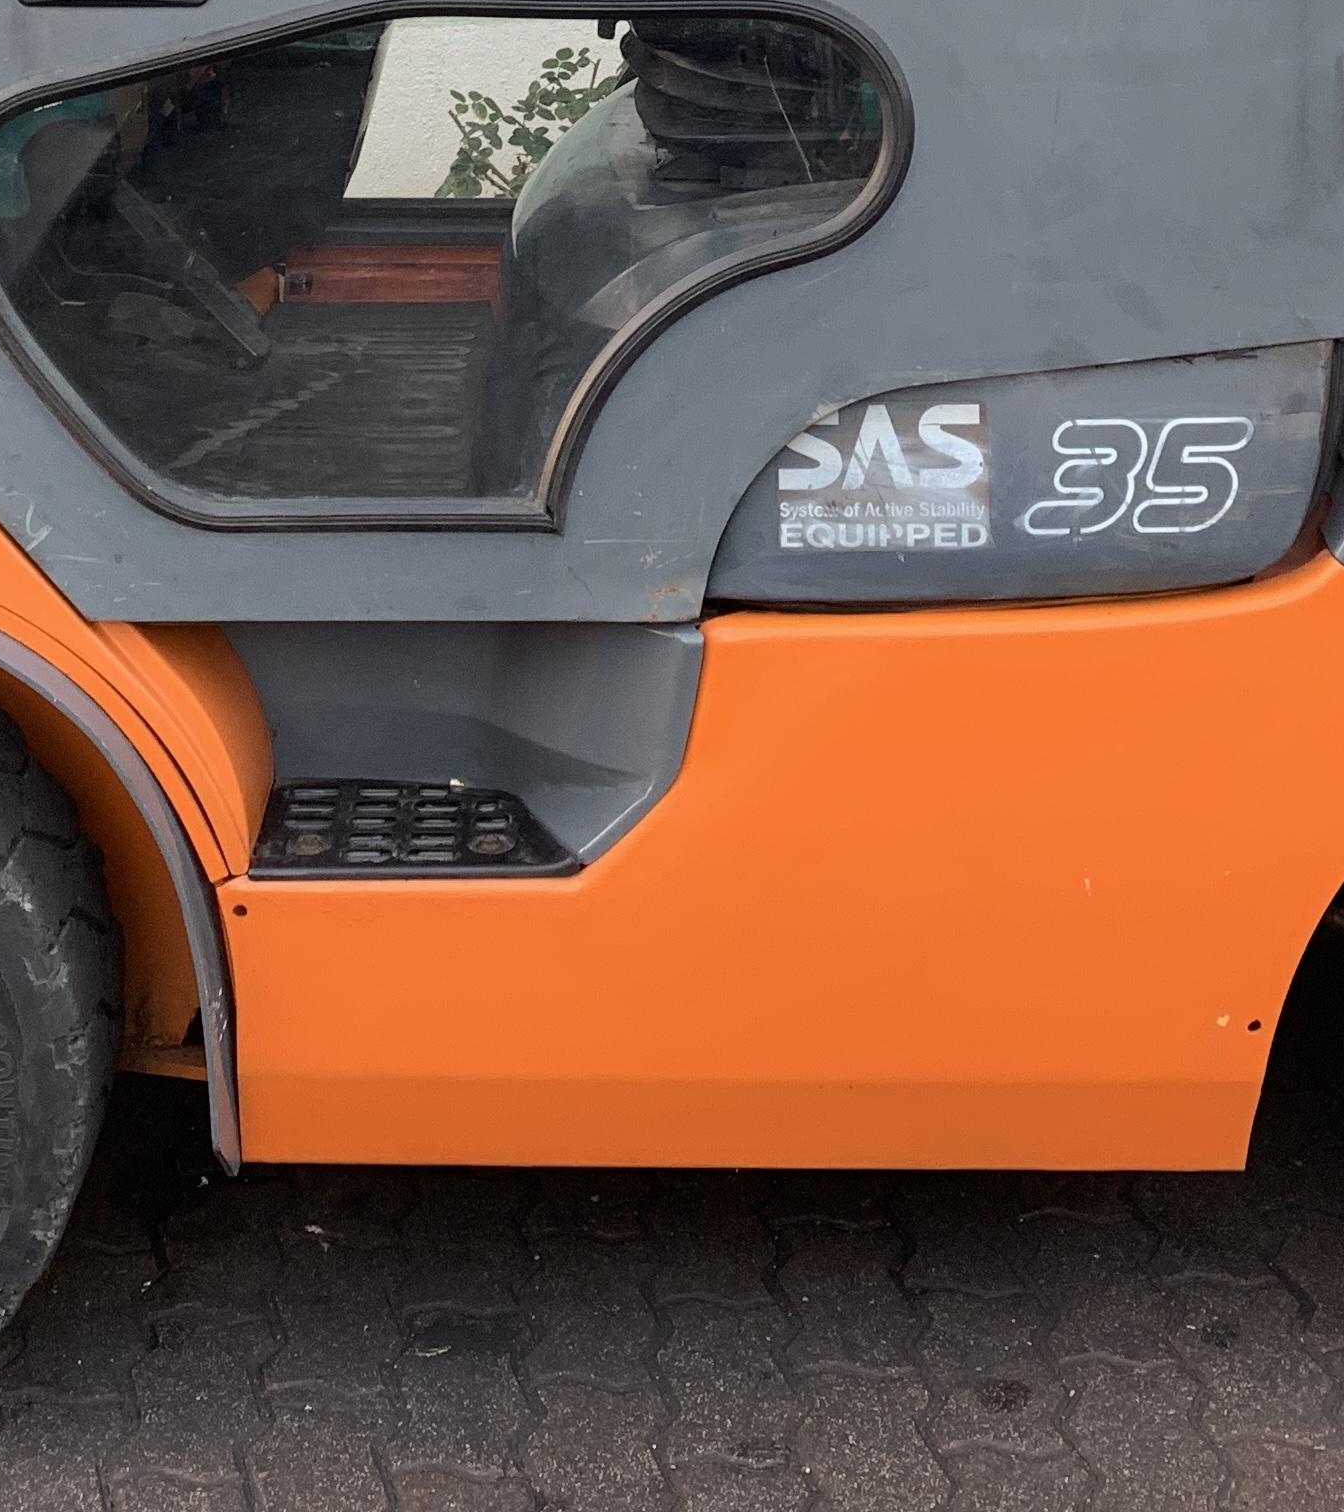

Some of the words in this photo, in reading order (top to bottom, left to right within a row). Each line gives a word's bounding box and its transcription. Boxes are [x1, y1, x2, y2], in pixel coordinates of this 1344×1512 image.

[778, 404, 984, 490] SAS
[1023, 417, 1254, 535] 35
[779, 523, 988, 549] EQUIPPED
[843, 502, 861, 518] of
[918, 501, 986, 521] Stability
